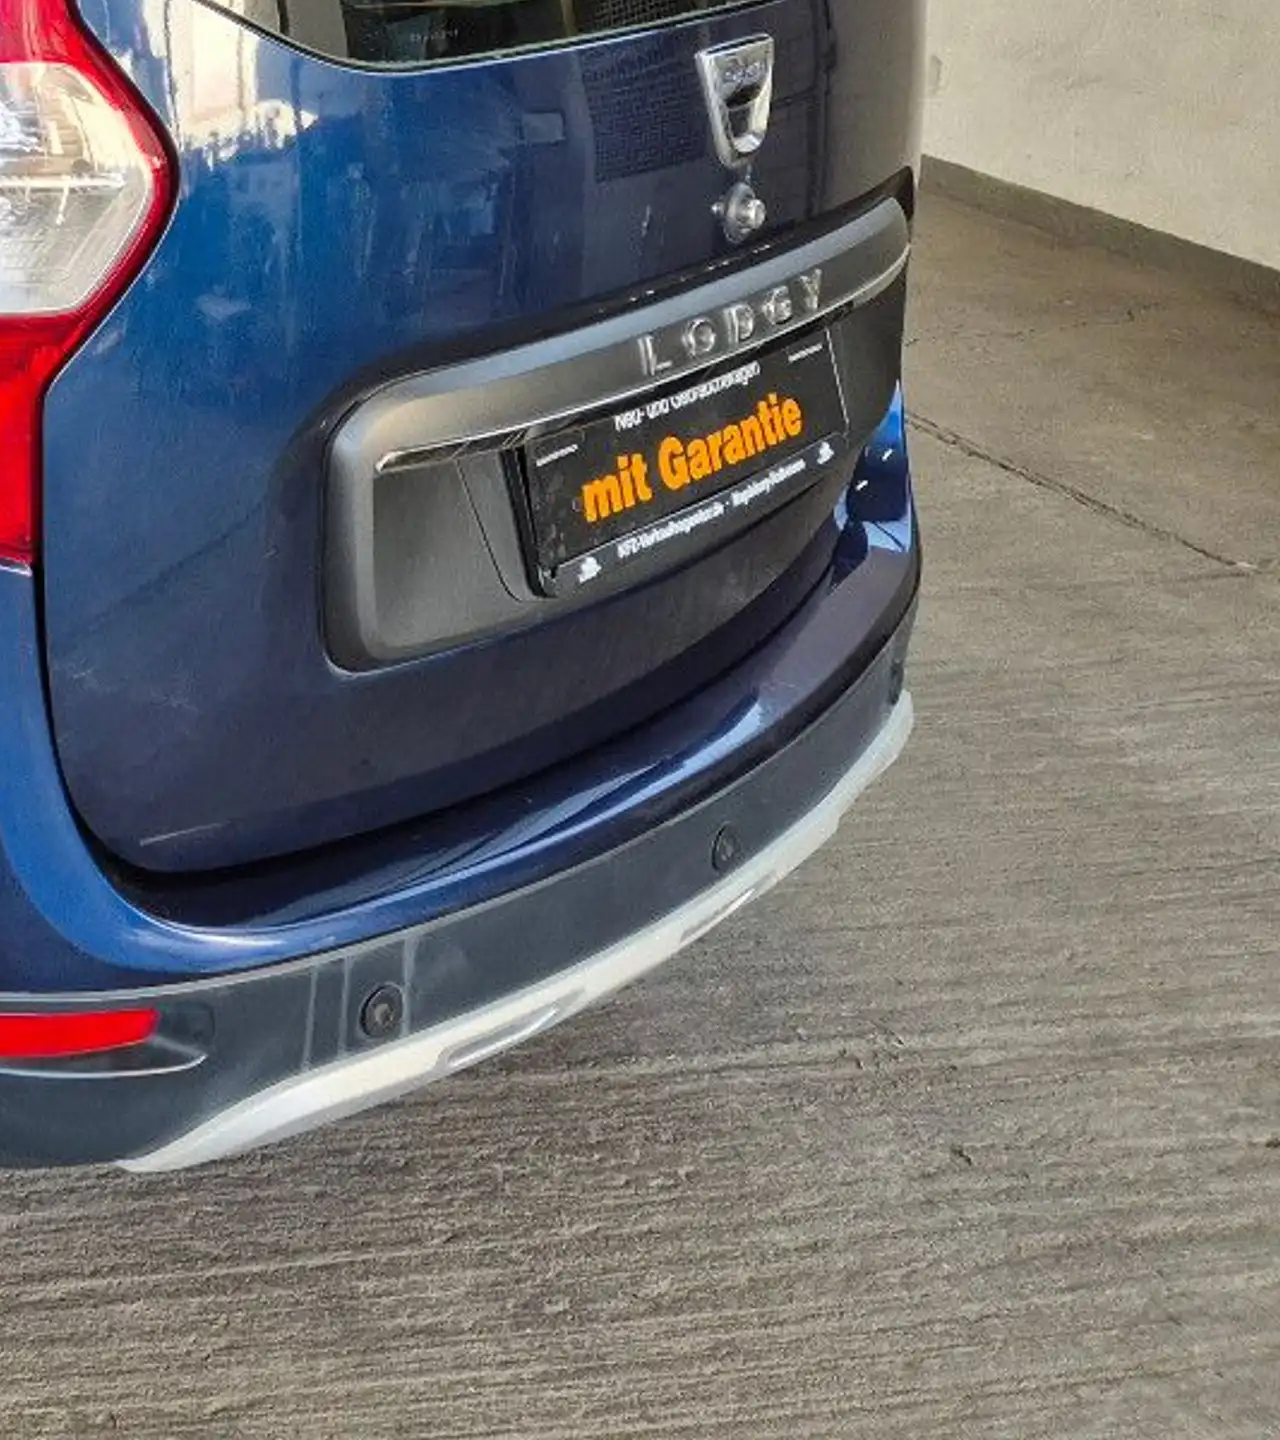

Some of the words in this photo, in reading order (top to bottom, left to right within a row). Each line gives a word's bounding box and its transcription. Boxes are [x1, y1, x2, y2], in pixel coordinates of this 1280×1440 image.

[637, 267, 823, 377] LODGY
[581, 452, 653, 523] mit
[657, 391, 804, 491] Garantie
